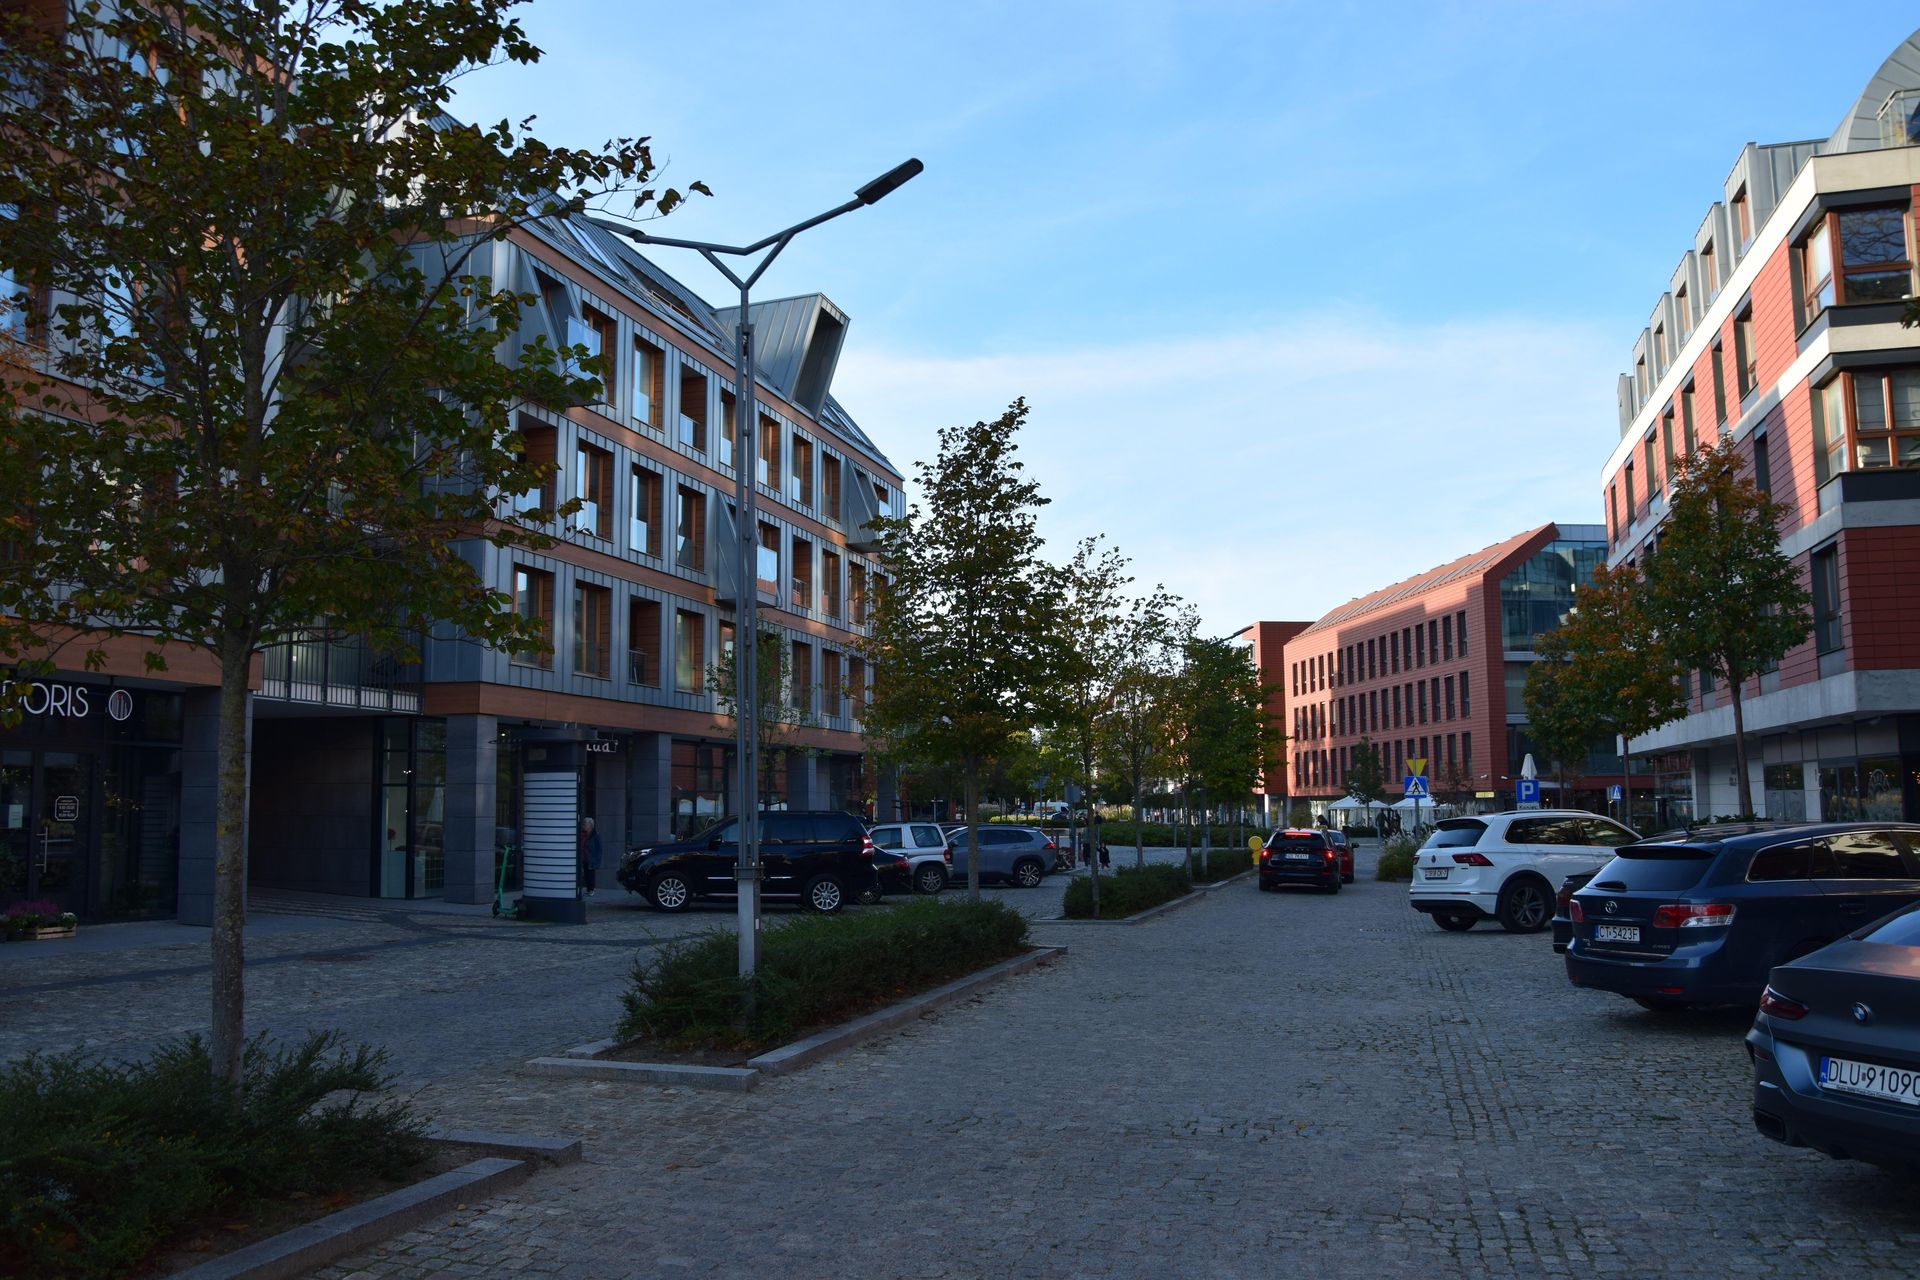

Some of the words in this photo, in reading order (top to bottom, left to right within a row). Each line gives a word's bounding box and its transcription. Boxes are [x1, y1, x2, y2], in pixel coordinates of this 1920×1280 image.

[1521, 781, 1534, 800] P
[1600, 926, 1611, 938] CT
[1612, 927, 1638, 940] 5423F
[1828, 1060, 1861, 1086] DLU
